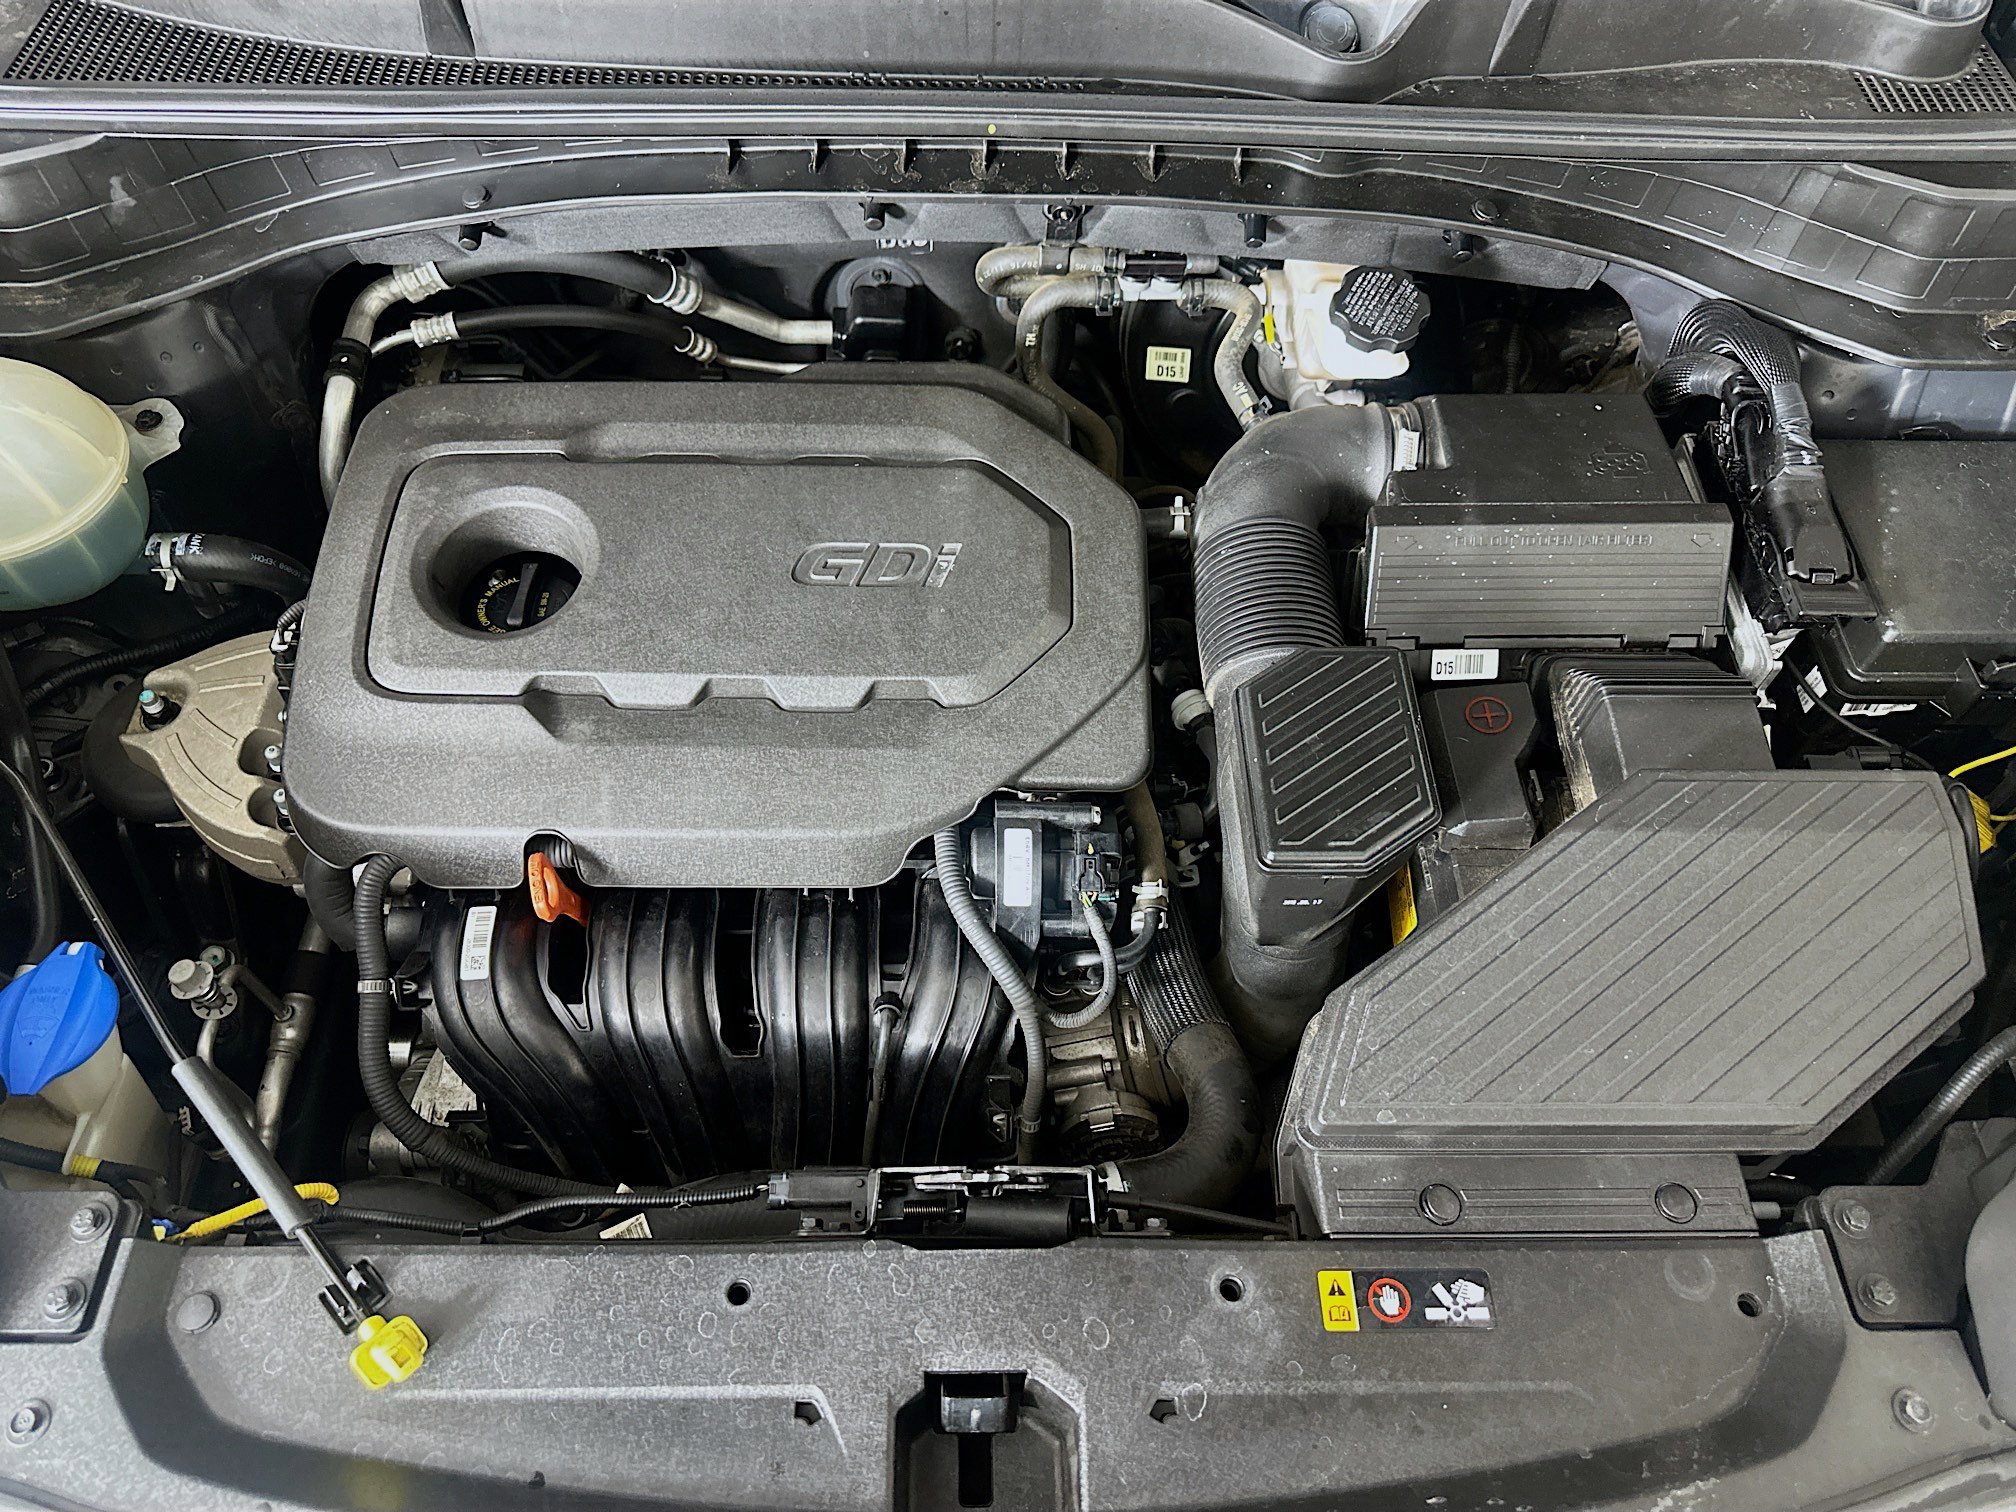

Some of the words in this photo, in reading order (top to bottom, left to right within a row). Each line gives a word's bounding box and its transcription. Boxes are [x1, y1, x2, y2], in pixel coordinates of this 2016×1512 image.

[1157, 365, 1176, 377] D15
[189, 533, 205, 555] ANK
[1455, 535, 1487, 547] PULL
[1538, 535, 1573, 547] OPEN
[791, 542, 963, 588] GDi
[477, 598, 491, 627] OWNER'S
[485, 577, 521, 597] MANUAL
[1436, 662, 1454, 675] D15
[531, 863, 540, 878] OIL
[533, 880, 544, 904] ENG
